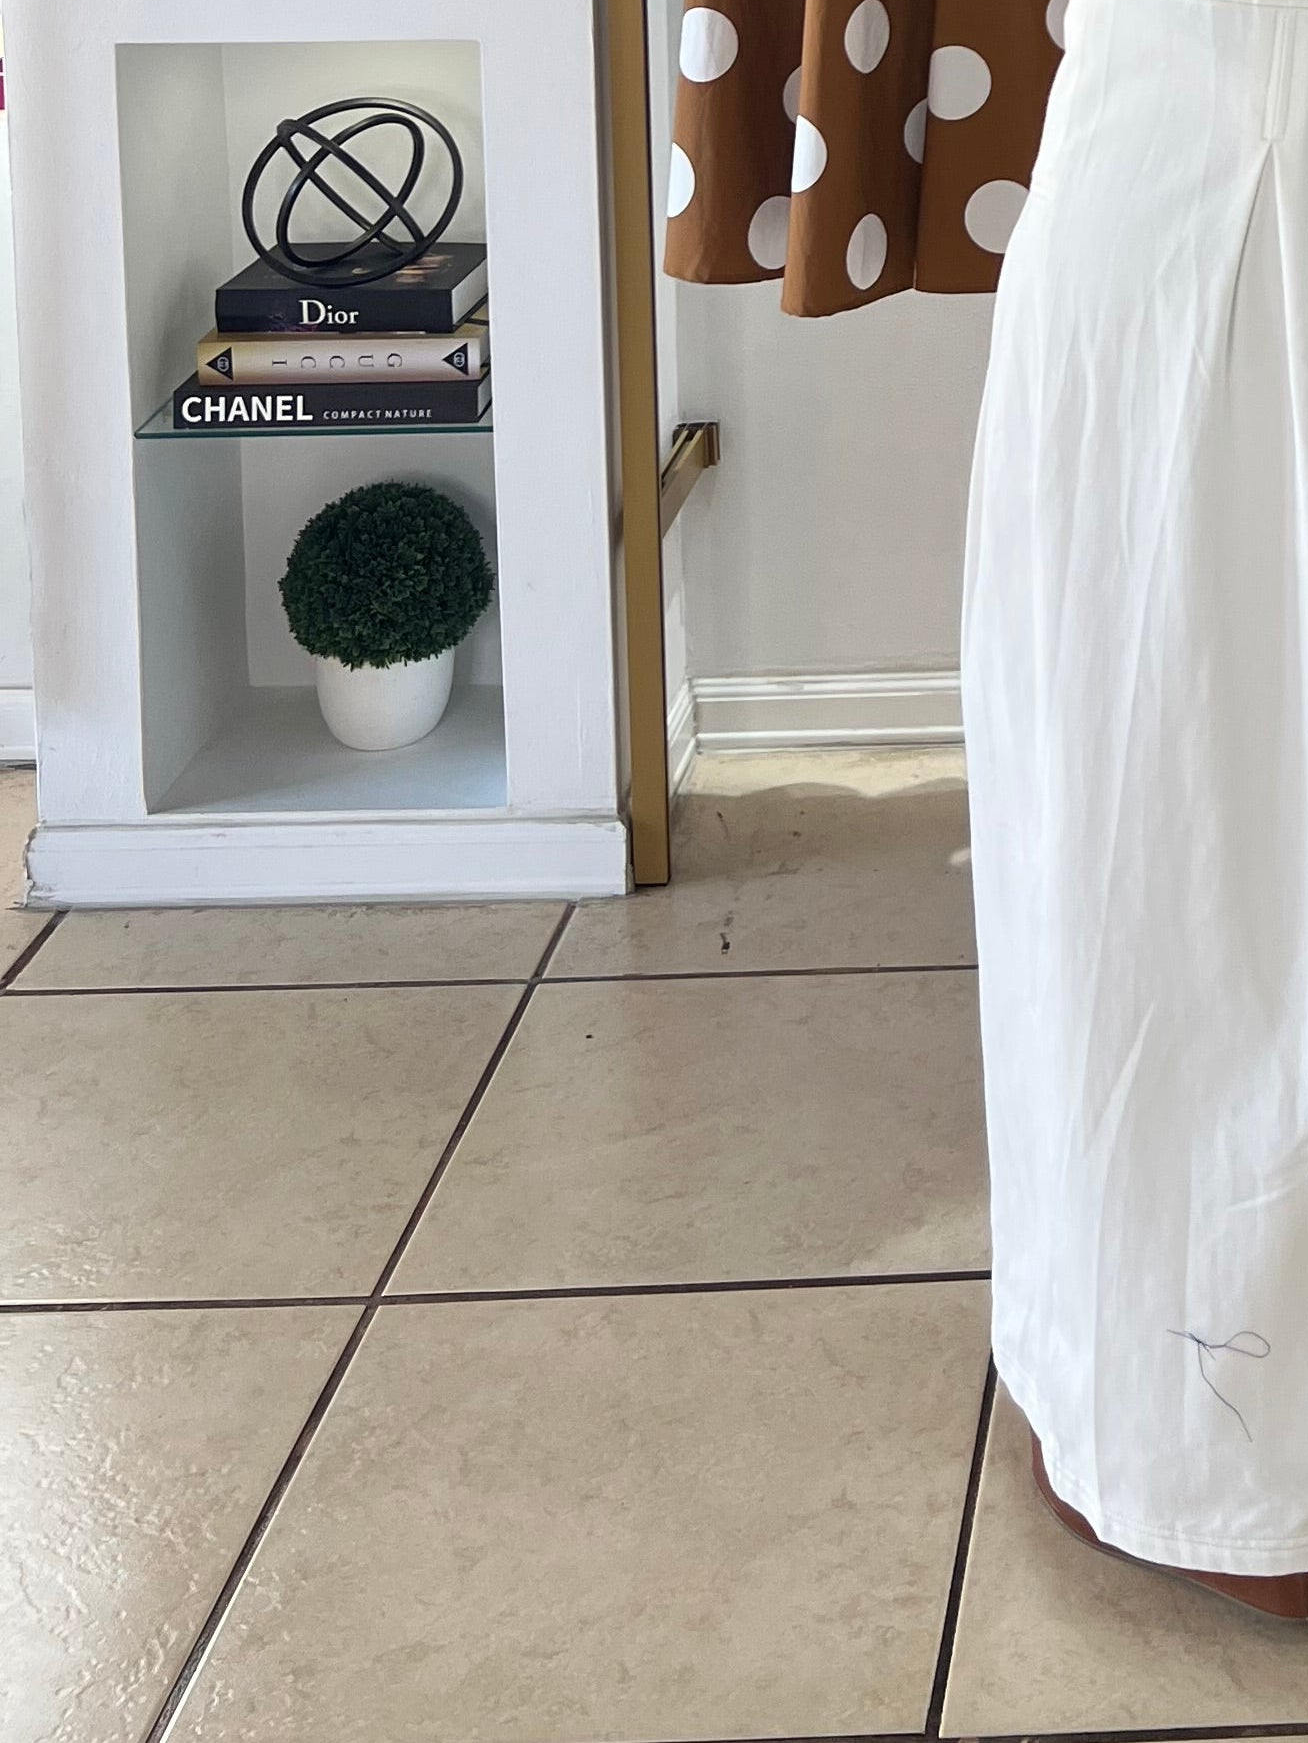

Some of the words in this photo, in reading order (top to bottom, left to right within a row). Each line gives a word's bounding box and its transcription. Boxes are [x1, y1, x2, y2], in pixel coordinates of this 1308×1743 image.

[299, 299, 359, 326] Dior
[271, 352, 403, 370] GUCCI
[181, 394, 314, 423] CHANEL
[323, 409, 381, 420] COMPACT
[384, 408, 433, 418] NATURE
